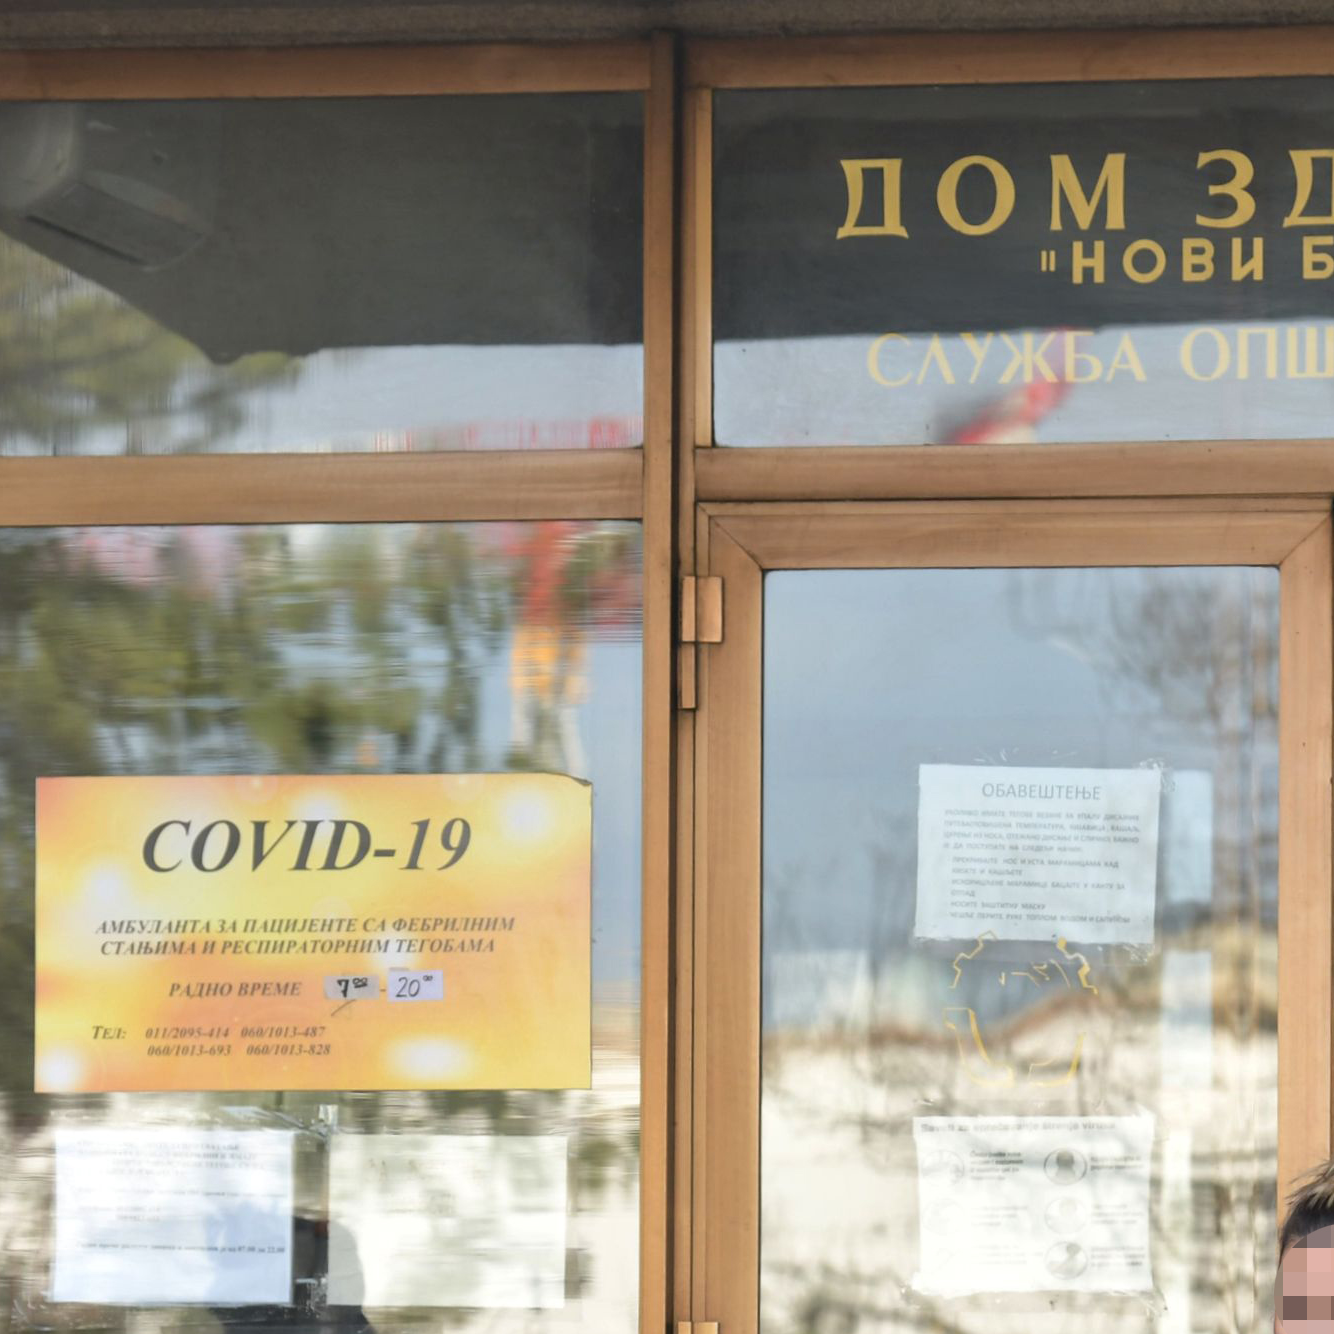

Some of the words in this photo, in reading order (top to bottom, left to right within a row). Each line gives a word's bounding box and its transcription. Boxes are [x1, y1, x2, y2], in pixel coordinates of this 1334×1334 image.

[837, 153, 1128, 240] ДОМ
[1039, 237, 1265, 284] "НОВИ
[865, 329, 1148, 388] СЛУЖБА
[982, 783, 1101, 800] ОБАВЕШТЕЊЕ
[142, 816, 472, 873] COVID-19
[95, 918, 213, 935] АМБУЛАНТА
[216, 918, 239, 934] ЗА
[242, 917, 358, 935] ПАЦИЈЕНТЕ
[362, 917, 388, 934] СА
[392, 916, 515, 933] ФЕБРИЛНИМ
[100, 939, 196, 956] СТАЊИМА
[201, 939, 216, 955] И
[220, 938, 389, 956] РЕСПИРАТОРНИМ
[394, 938, 495, 954] ТЕГОБАМА
[168, 982, 233, 998] РАДНО
[237, 981, 302, 997] ВРЕМЕ
[145, 1027, 230, 1039] 011/2095-414
[240, 1027, 326, 1038] 060/1013-487
[147, 1044, 231, 1056] 060/1013-693
[246, 1044, 331, 1056] 060/1013-828
